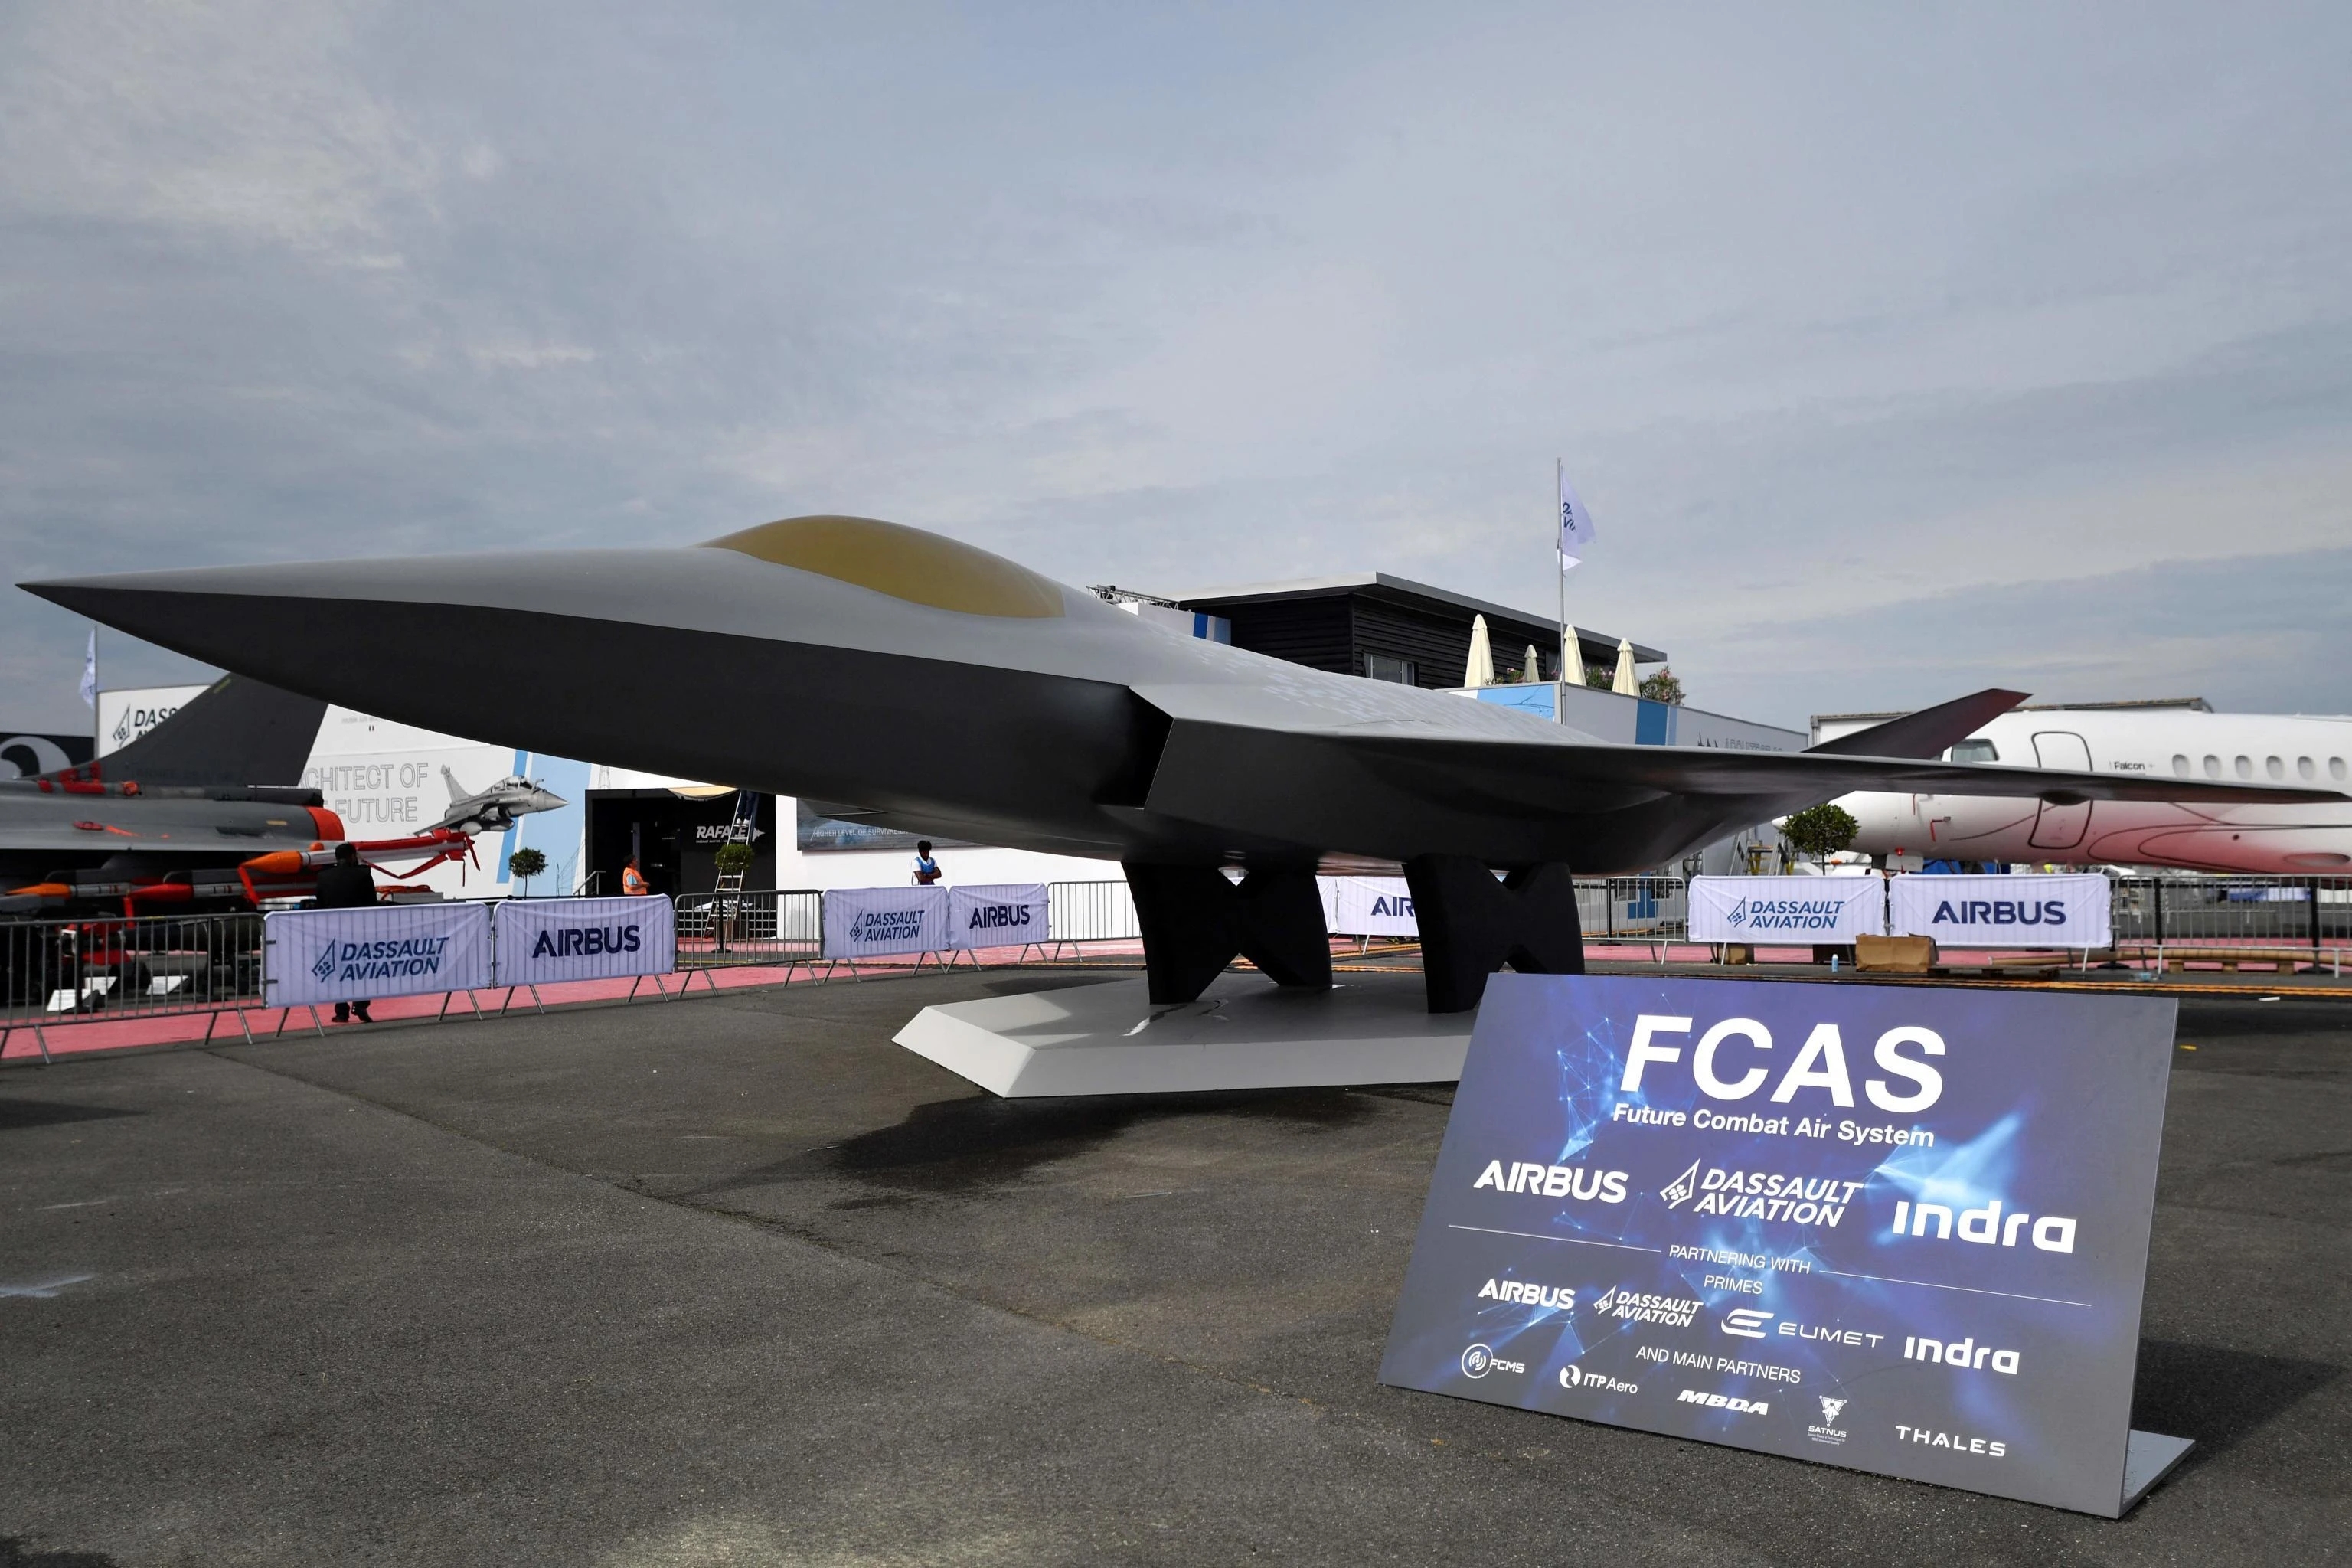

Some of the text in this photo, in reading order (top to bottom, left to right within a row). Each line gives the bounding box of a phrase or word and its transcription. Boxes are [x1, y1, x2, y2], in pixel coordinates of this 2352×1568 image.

[300, 763, 428, 791] CHITECT OF
[2114, 761, 2145, 770] Falcon
[335, 797, 418, 823] FUTURE
[865, 910, 925, 926] DASSAULT
[969, 904, 1031, 929] AIRBUS
[1750, 900, 1844, 913] DASSAULT
[1932, 900, 2066, 926] AIRBUS
[864, 926, 920, 942] AVIATION
[1749, 916, 1838, 929] AVIATION
[341, 937, 449, 962] DASSAULT
[531, 925, 641, 958] AIRBUS
[339, 957, 439, 982] AVIATION
[1620, 1014, 1946, 1113] FCAS
[1612, 1102, 1935, 1148] Future Combat Air System
[1473, 1160, 1629, 1204] AIRBUS
[1700, 1168, 1865, 1205] DASSAULT
[1693, 1194, 1845, 1227] AVIATION
[1669, 1245, 1811, 1275] PARTNERING WITH
[1478, 1279, 1576, 1310] AIRBUS
[1704, 1274, 1763, 1294] PRIMES
[1615, 1291, 1704, 1315] DASSAULT
[1612, 1306, 1694, 1328] AVIATION
[1778, 1321, 1885, 1348] EUMET
[1490, 1358, 1525, 1374] FCMS
[1635, 1346, 1802, 1383] AND MAIN PARTNERS
[1808, 1425, 1847, 1438] SATNUS
[1895, 1425, 2007, 1457] THALES
